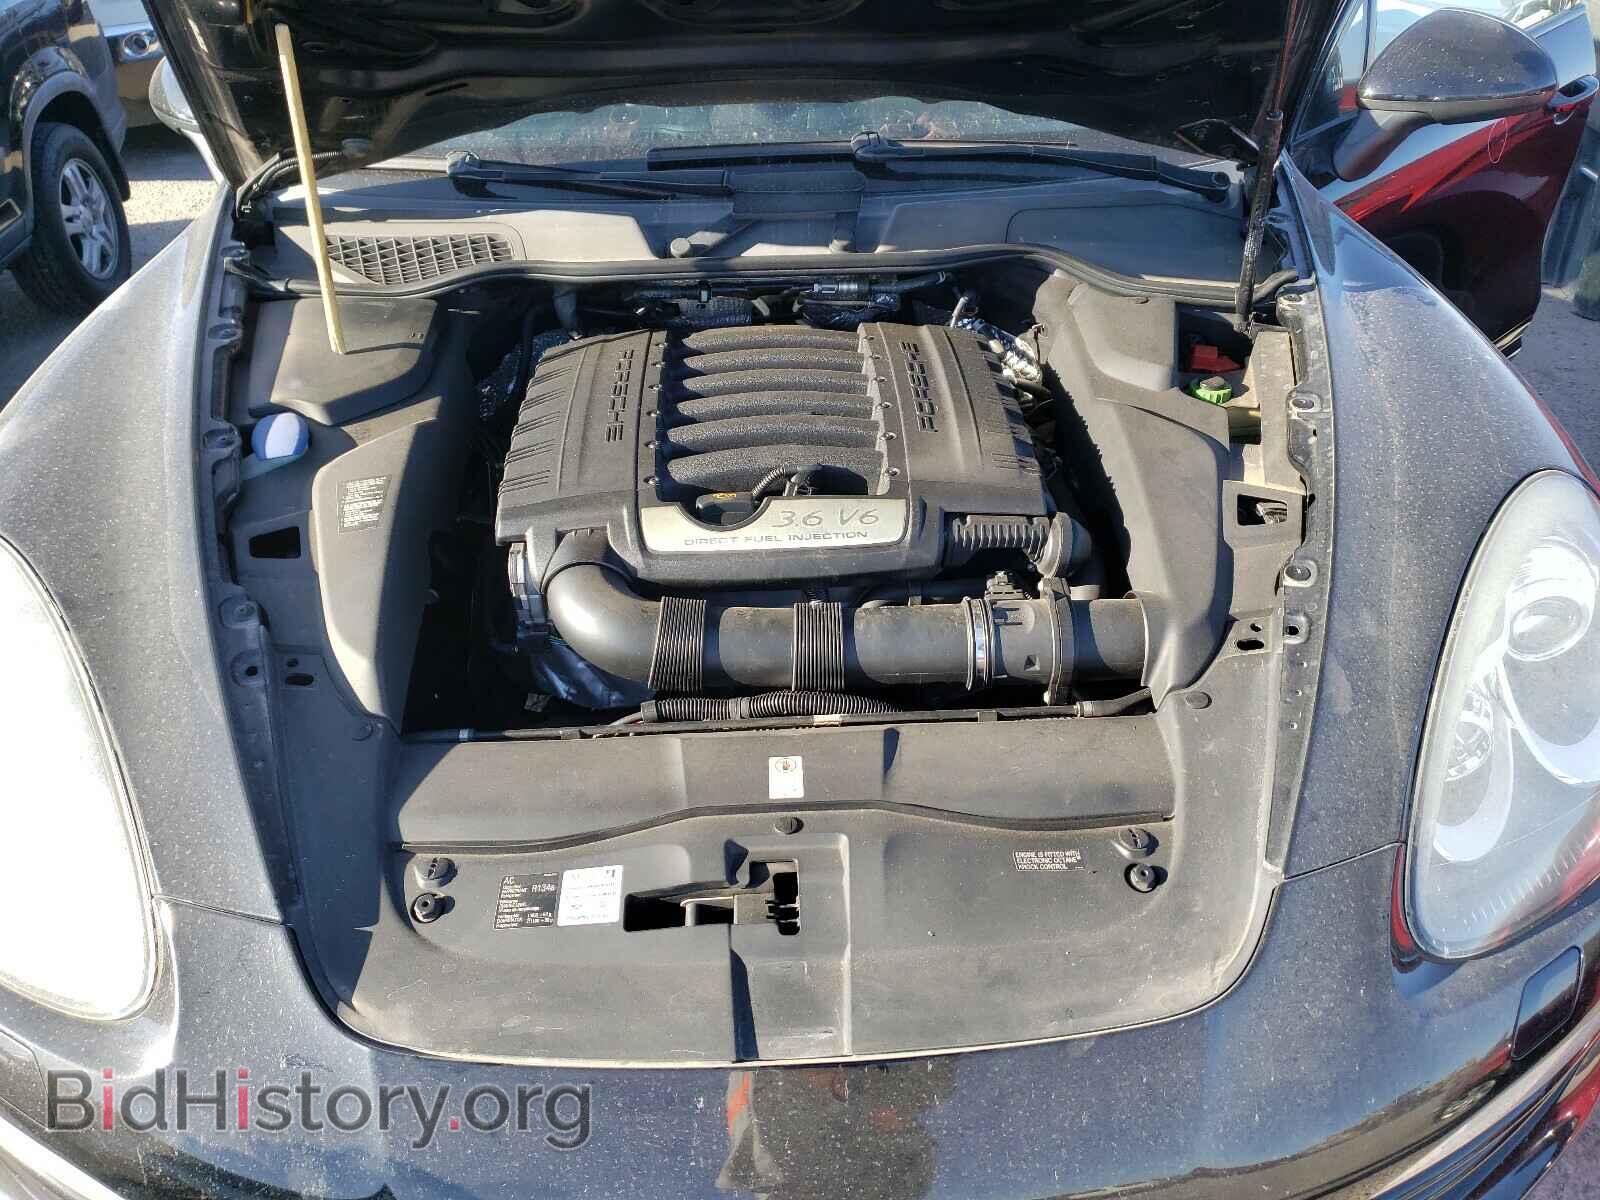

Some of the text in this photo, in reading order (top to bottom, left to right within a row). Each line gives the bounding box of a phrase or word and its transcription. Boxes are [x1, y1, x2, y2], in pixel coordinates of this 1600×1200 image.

[604, 348, 636, 442] PORSCHE
[899, 342, 939, 432] PORSCHE
[772, 508, 880, 528] 3.6 V6
[684, 531, 868, 546] DIRECT FUEL INJECTION
[503, 876, 515, 885] AC
